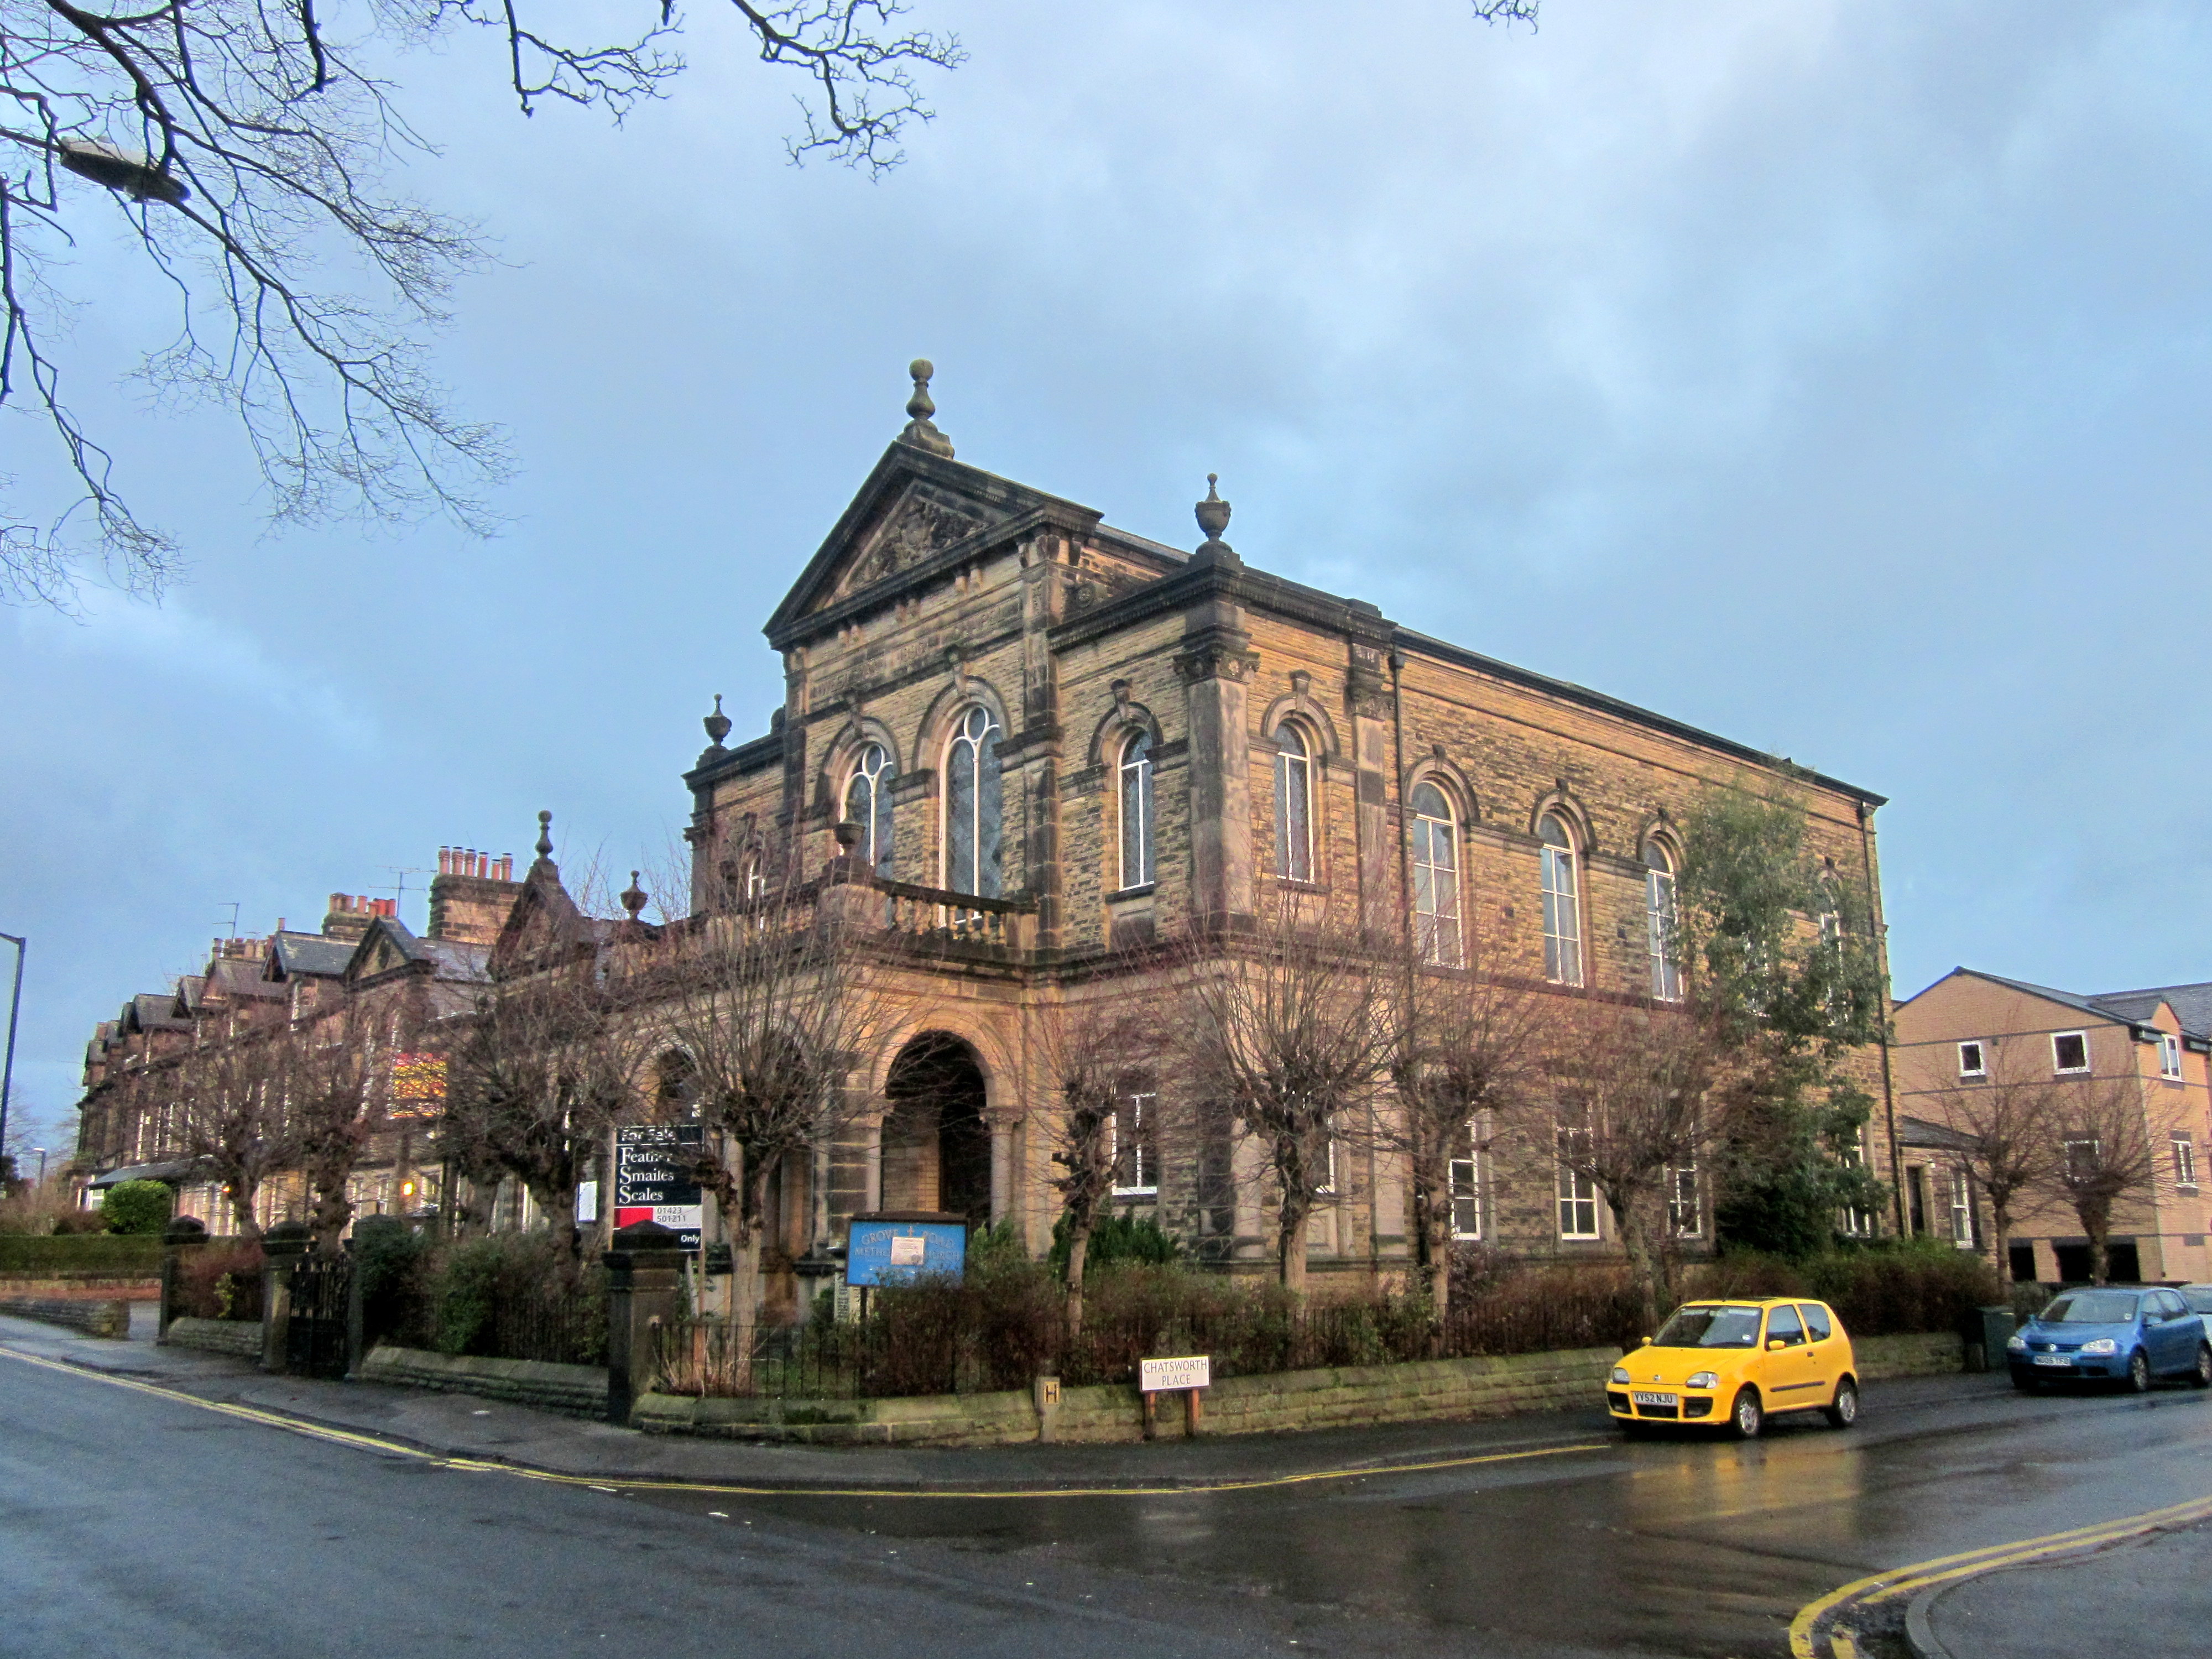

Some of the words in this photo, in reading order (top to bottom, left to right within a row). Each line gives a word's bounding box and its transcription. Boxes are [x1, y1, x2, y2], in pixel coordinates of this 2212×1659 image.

[619, 1166, 674, 1185] Smailes
[619, 1186, 664, 1204] Scales
[681, 1234, 700, 1244] Only
[1144, 1359, 1207, 1374] CHATSWORTH
[1162, 1375, 1191, 1386] PLACE
[1046, 1383, 1057, 1404] H
[1656, 1394, 1673, 1404] NJU
